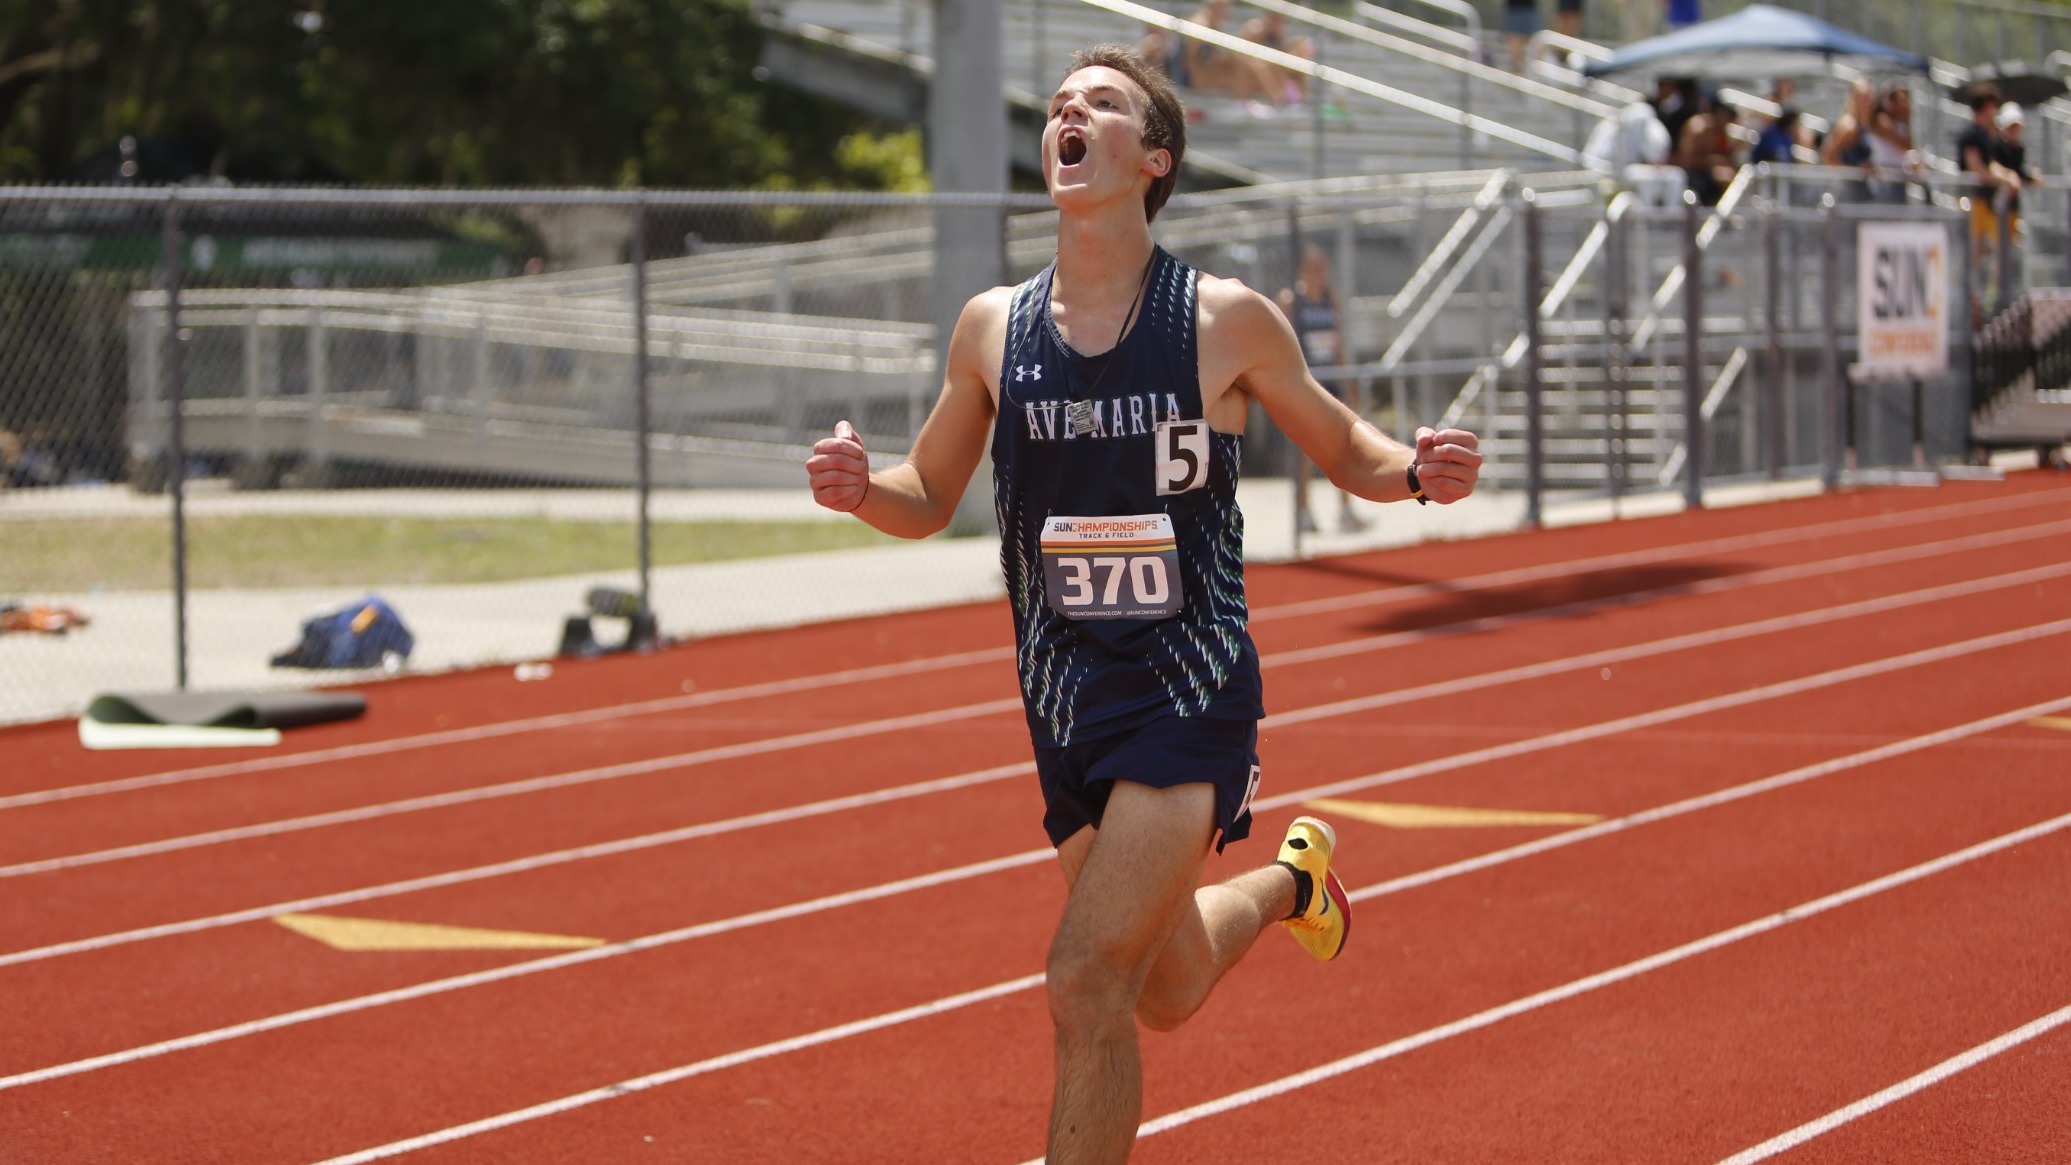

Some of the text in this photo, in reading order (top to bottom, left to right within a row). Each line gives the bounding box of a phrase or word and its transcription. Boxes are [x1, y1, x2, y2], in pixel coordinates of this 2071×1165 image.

[1025, 400, 1077, 440] AVE
[1090, 393, 1181, 438] MARIA
[1168, 425, 1198, 491] 5
[1057, 556, 1169, 605] 370
